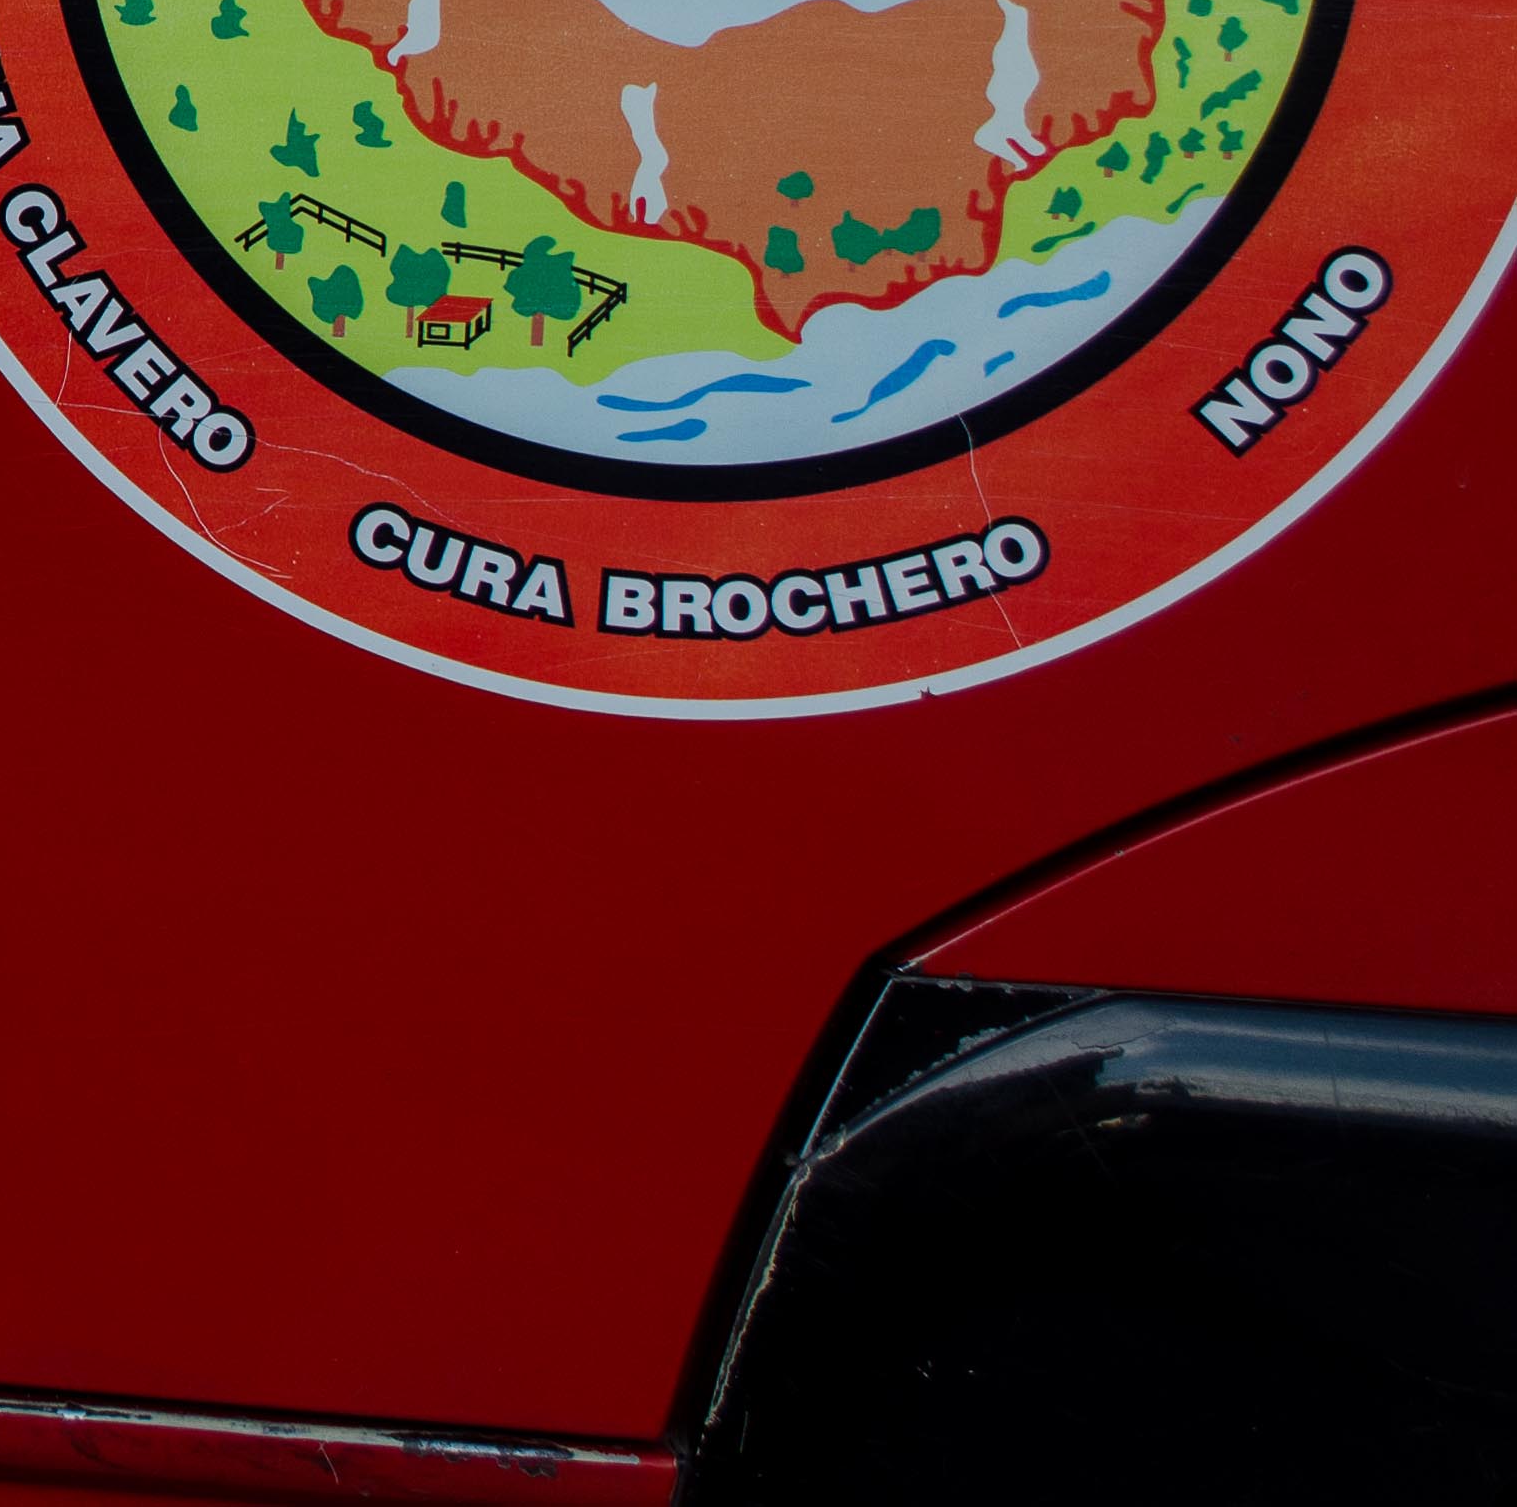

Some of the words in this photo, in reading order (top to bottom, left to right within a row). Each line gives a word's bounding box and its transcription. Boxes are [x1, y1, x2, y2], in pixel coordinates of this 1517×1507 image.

[0, 183, 256, 474] CLAVERO
[1191, 244, 1393, 457] NONO
[348, 501, 573, 627] CURA
[600, 515, 1049, 640] BROCHERO
